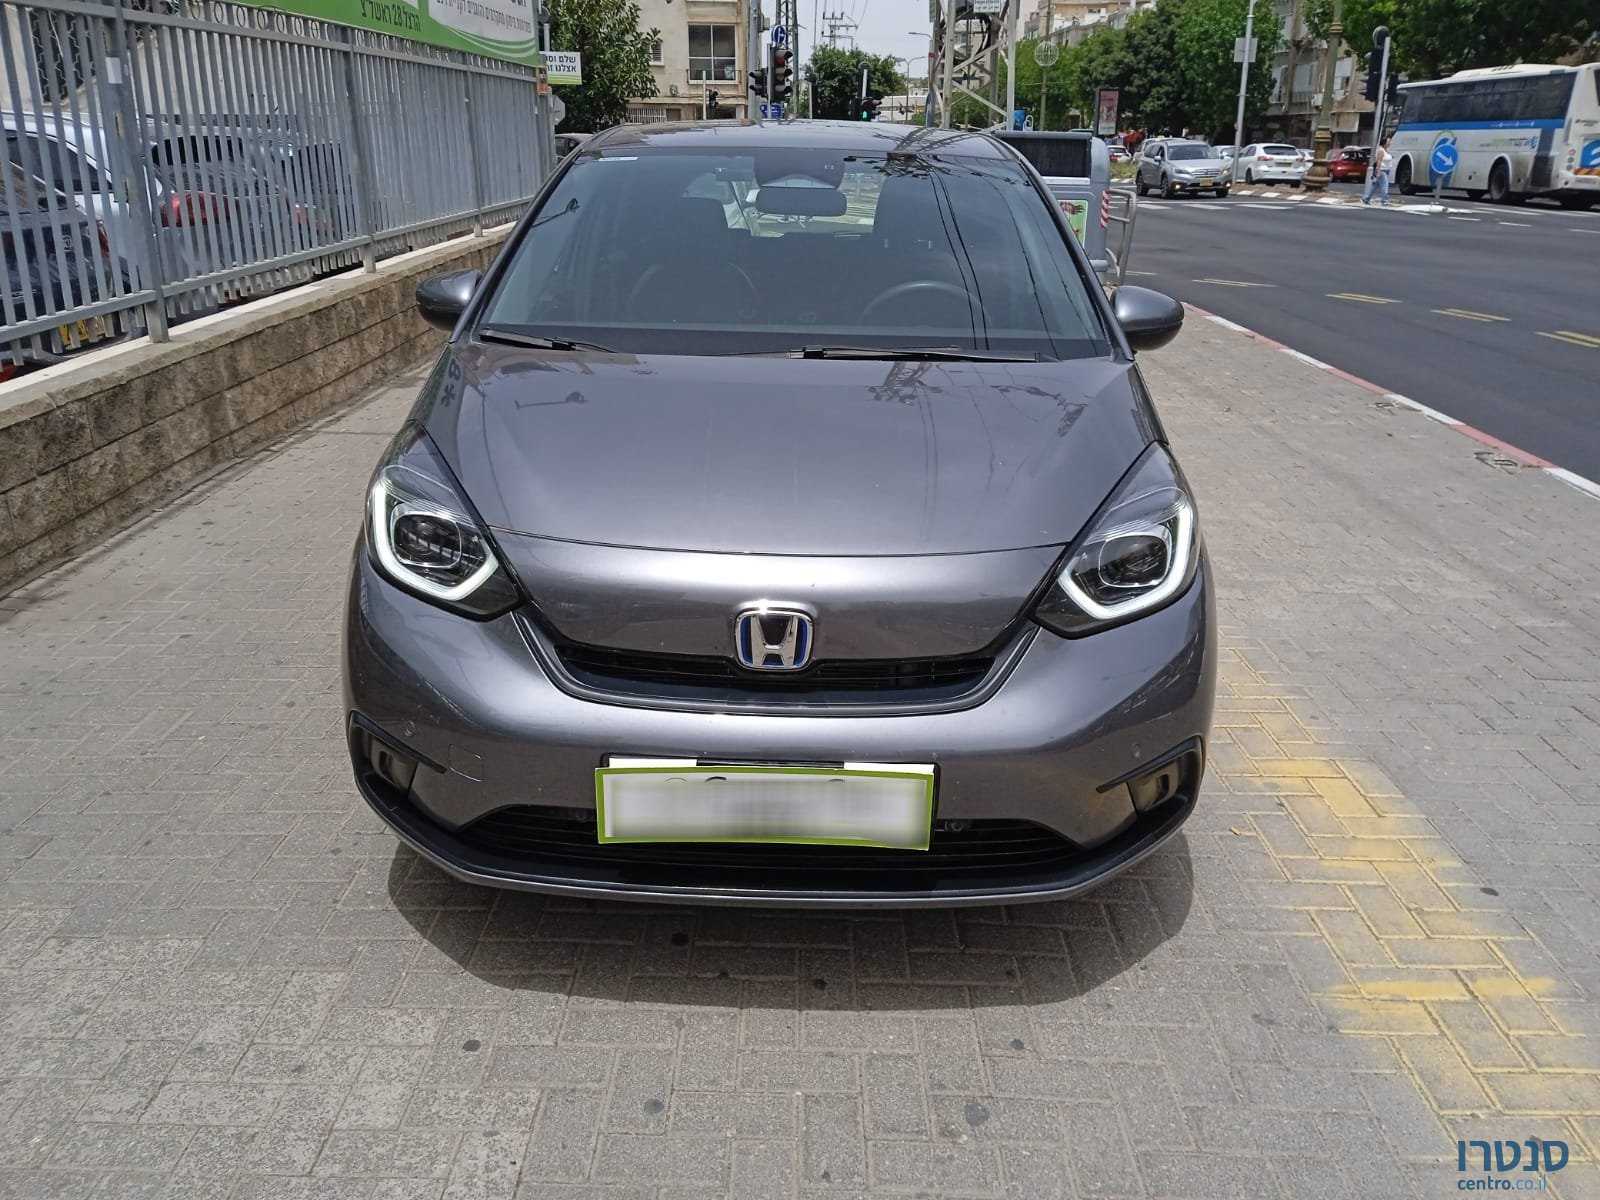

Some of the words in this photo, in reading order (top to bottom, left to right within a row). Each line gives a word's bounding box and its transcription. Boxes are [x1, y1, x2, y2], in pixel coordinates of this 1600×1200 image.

[392, 3, 403, 27] 28
[558, 54, 576, 63] שלם
[556, 64, 577, 73] אצלנו
